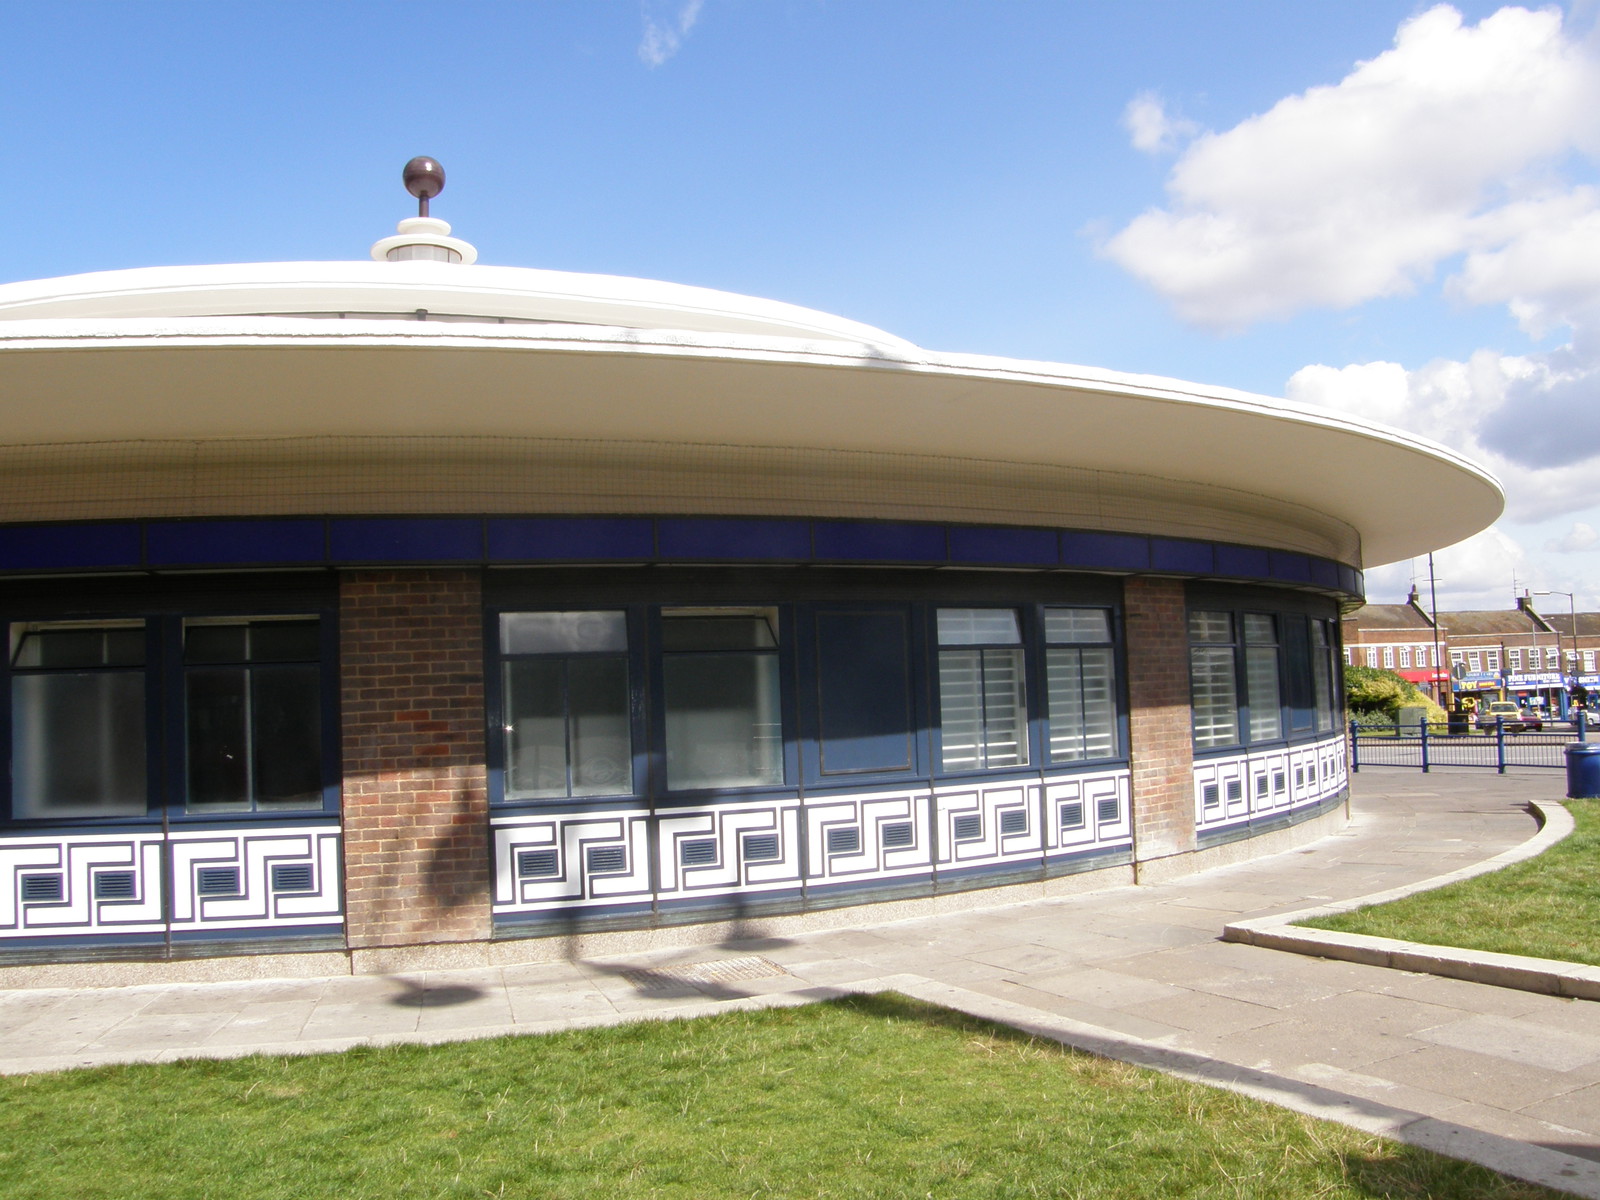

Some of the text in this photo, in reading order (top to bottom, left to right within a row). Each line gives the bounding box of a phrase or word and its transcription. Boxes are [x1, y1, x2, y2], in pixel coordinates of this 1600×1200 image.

[1508, 674, 1523, 682] PINE
[1524, 673, 1560, 682] FURNITURE
[1461, 680, 1477, 689] TOY
